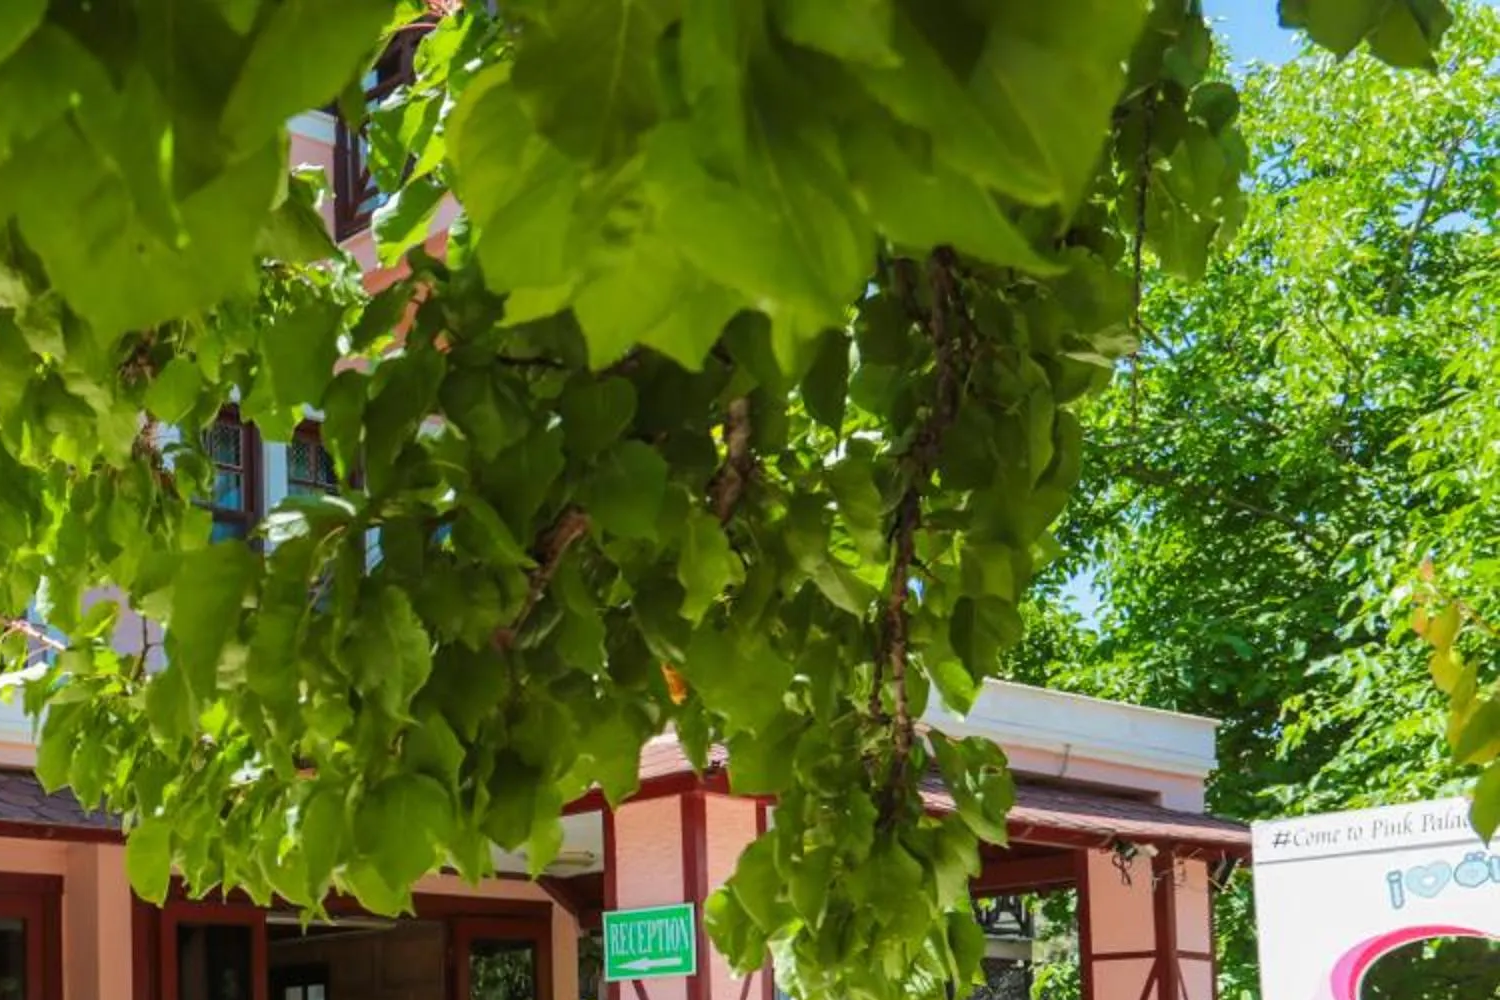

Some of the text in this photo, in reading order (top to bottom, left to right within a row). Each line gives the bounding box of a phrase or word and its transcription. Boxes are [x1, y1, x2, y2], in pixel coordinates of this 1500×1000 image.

[1271, 808, 1470, 849] #Come to Pink Palac
[608, 916, 690, 957] RECEPTION
